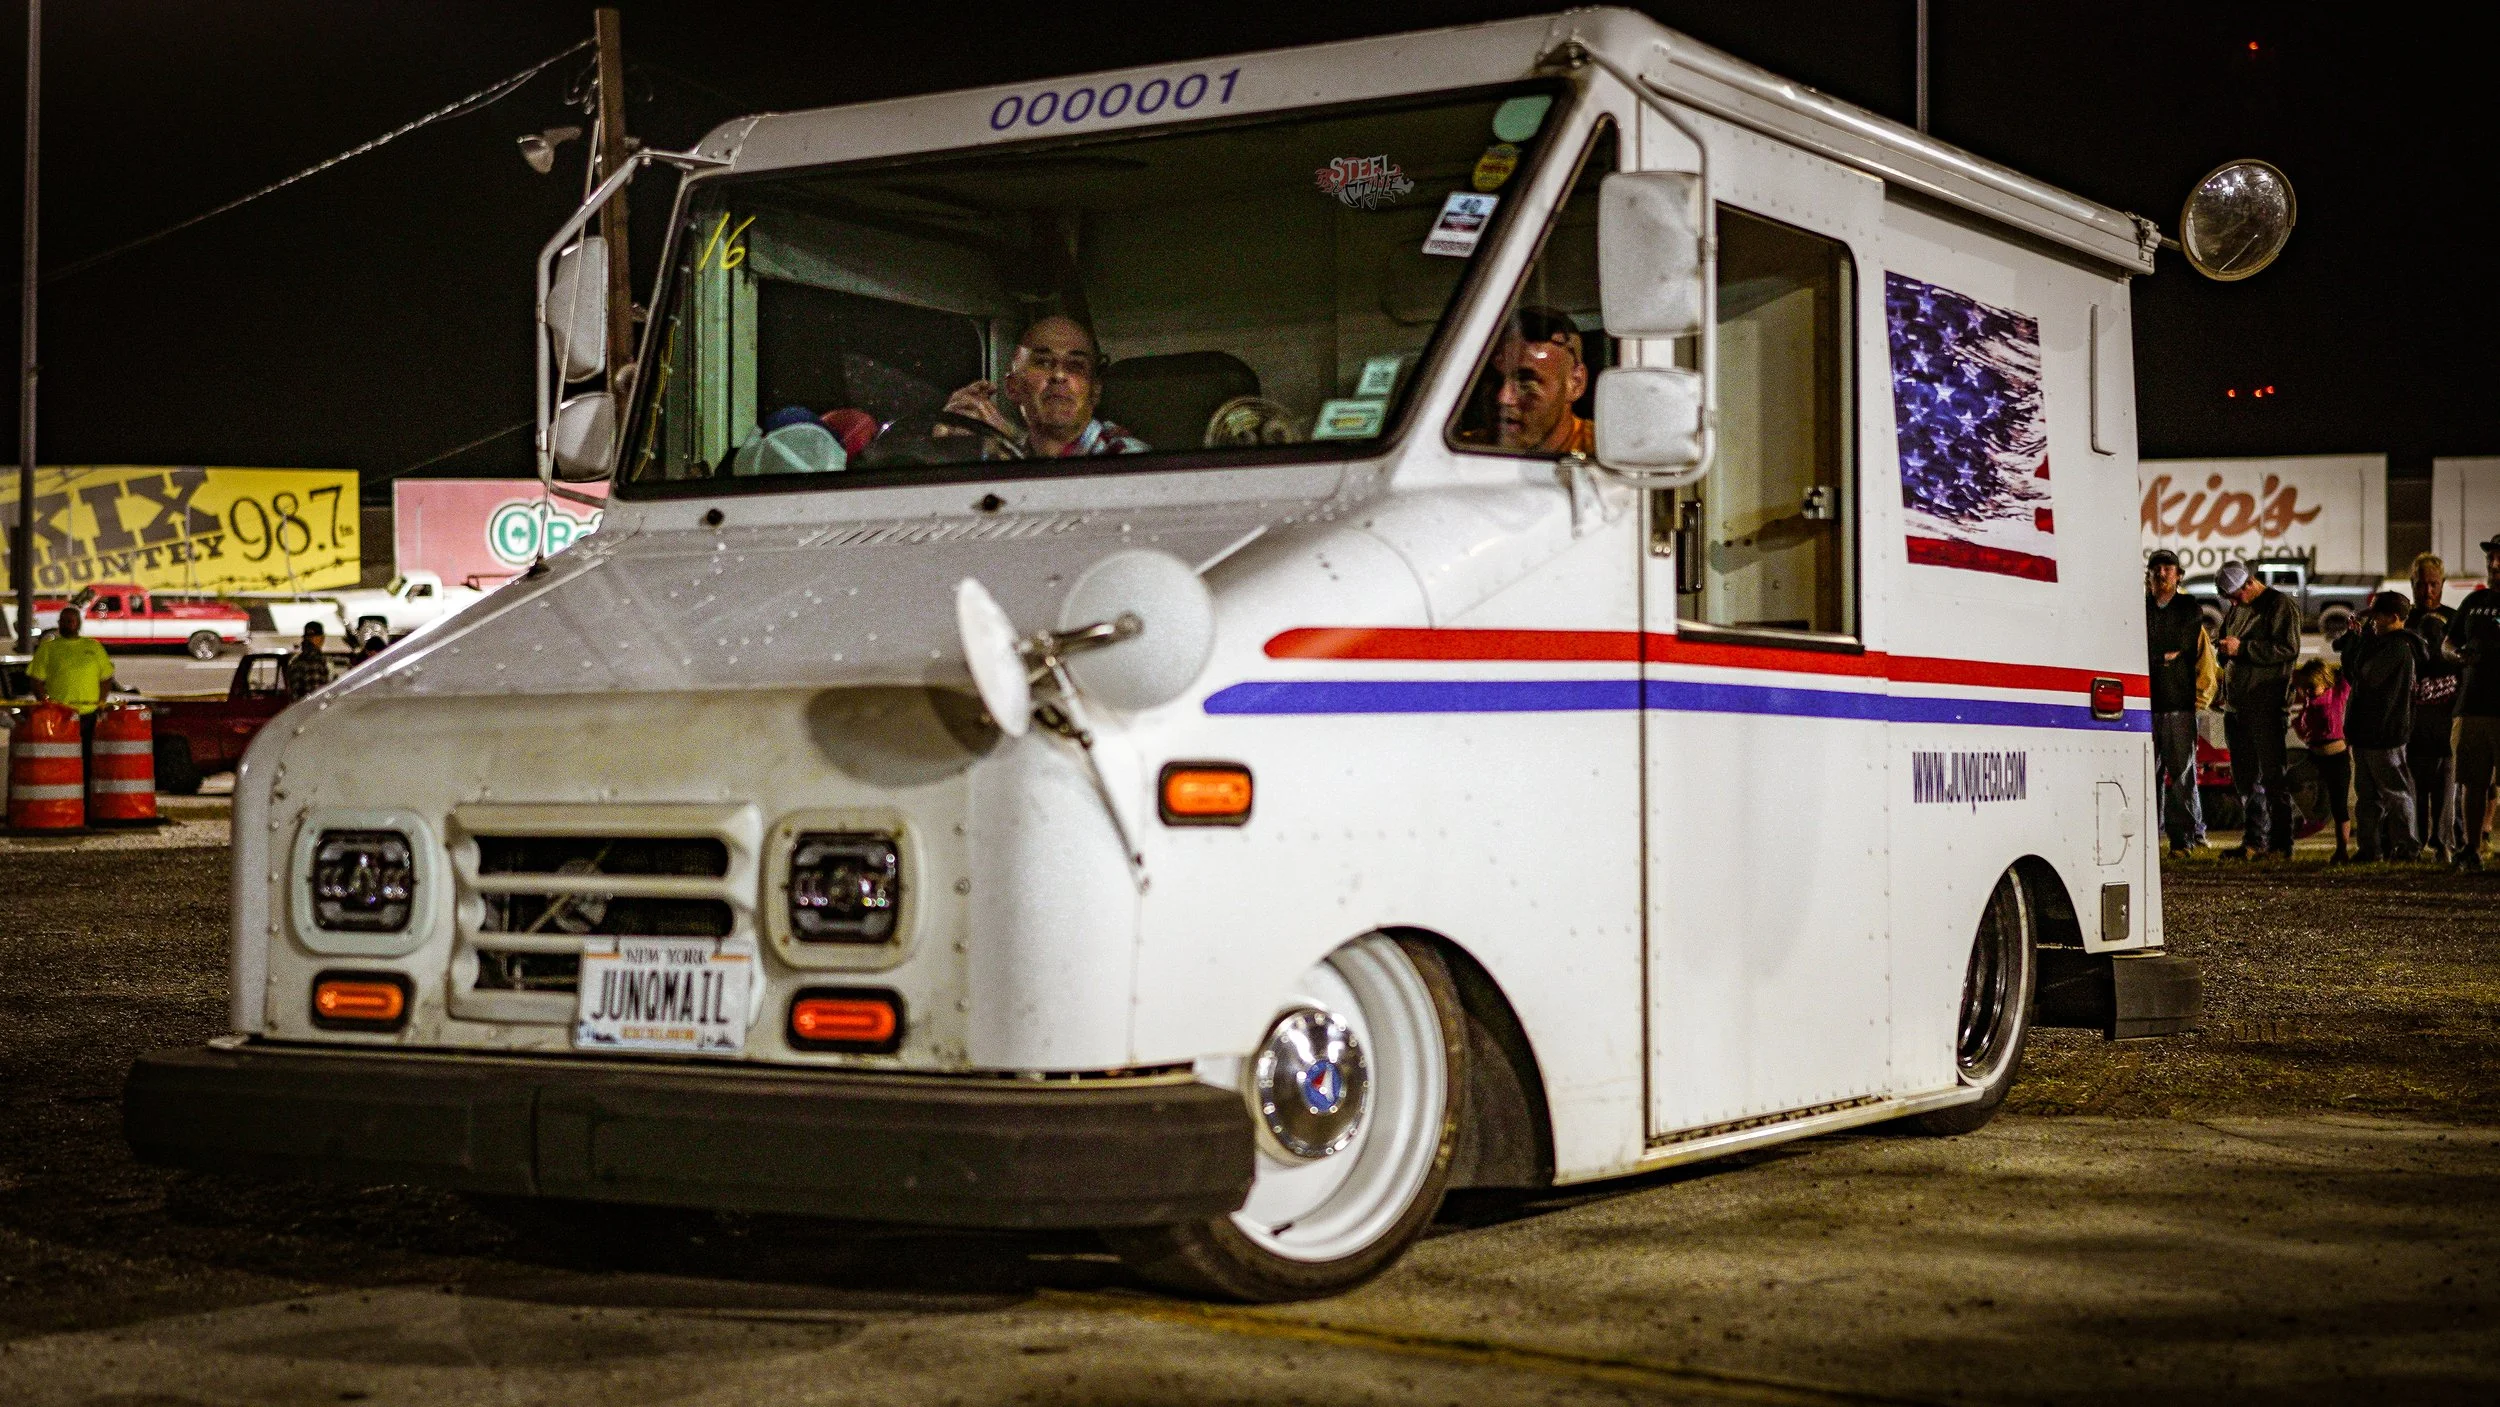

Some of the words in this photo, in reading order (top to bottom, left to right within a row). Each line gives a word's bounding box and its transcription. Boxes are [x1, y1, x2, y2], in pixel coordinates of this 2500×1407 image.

[990, 66, 1241, 130] 0000001
[1329, 154, 1400, 182] STEEL
[698, 211, 756, 270] 16
[229, 484, 342, 562] 98.7
[2139, 472, 2322, 541] kip's
[36, 534, 225, 588] OUNTRY
[625, 948, 661, 964] NEW
[668, 948, 707, 964] YORK
[591, 970, 728, 1024] JUNQMAIL
